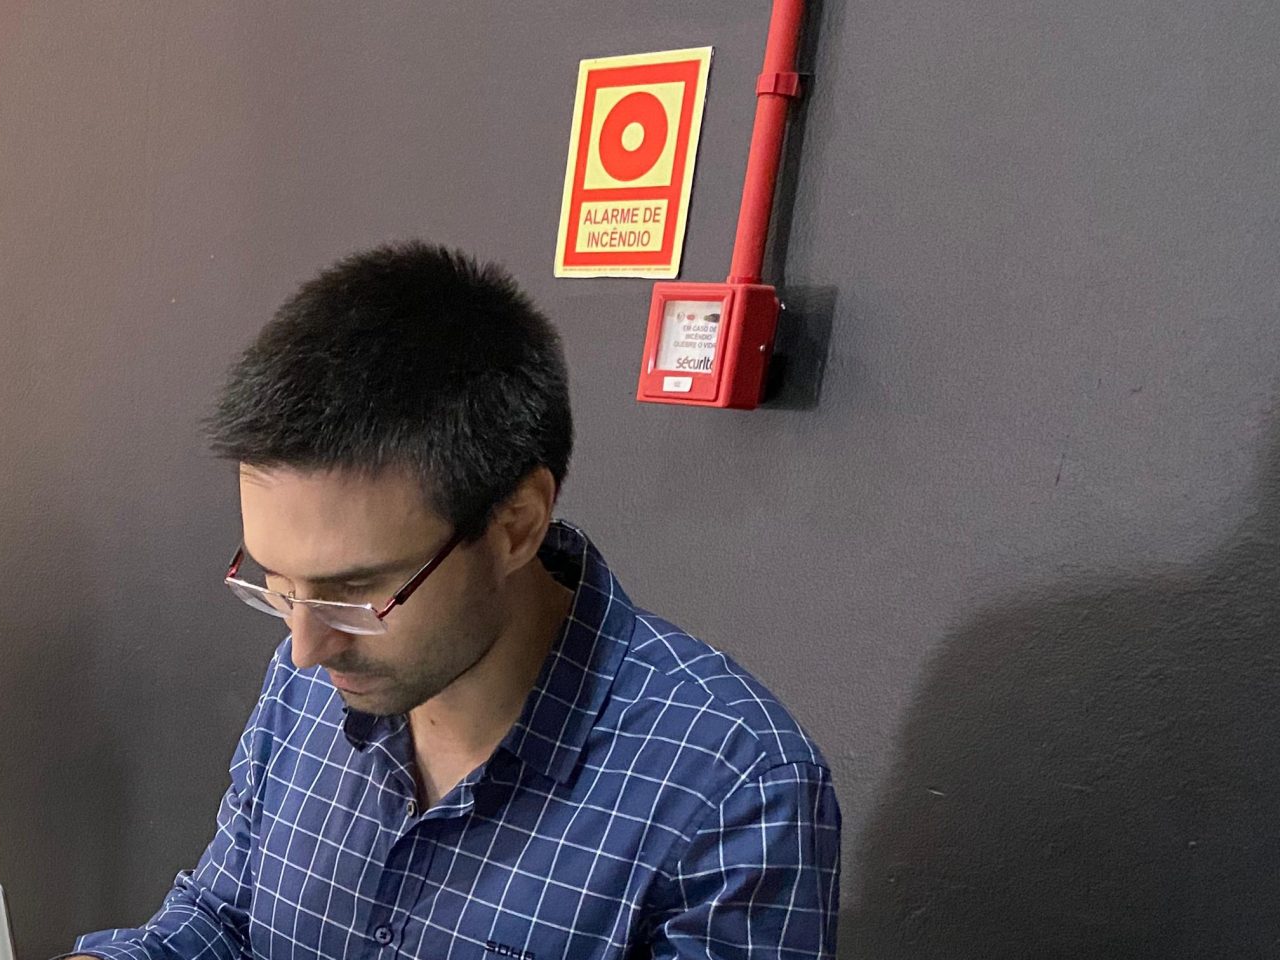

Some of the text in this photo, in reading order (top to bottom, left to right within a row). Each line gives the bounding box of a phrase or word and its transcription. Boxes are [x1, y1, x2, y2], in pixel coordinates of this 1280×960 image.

[584, 206, 662, 225] ALARME DE
[587, 227, 651, 248] INCÊNDIO
